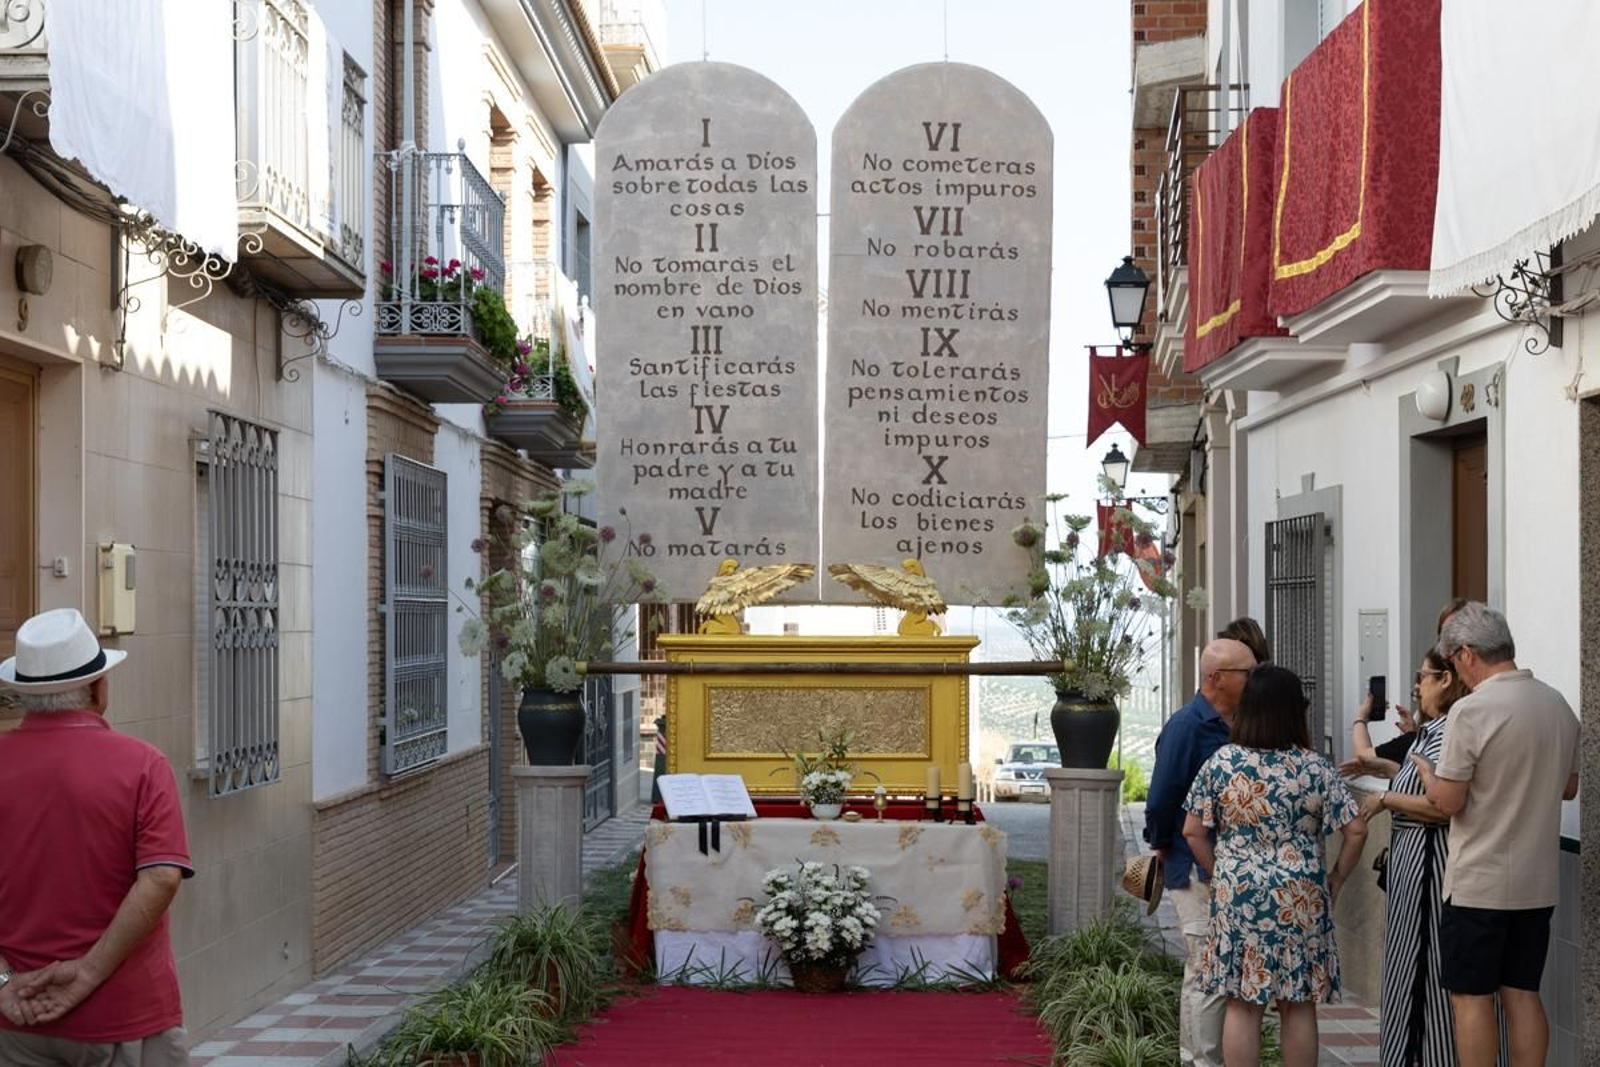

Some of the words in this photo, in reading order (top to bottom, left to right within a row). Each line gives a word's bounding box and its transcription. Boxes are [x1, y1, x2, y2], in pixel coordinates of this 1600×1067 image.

[701, 118, 710, 147] I
[922, 122, 961, 152] VI
[612, 152, 714, 171] Amarás
[721, 157, 736, 170] a
[747, 152, 796, 170] Dios
[863, 153, 892, 171] No
[612, 176, 680, 194] sobre
[686, 175, 757, 193] todas
[770, 175, 808, 193] las
[851, 178, 922, 195] actos
[936, 179, 1036, 204] impuros
[670, 202, 744, 216] cosas
[914, 206, 964, 236] VII
[695, 224, 718, 252] II
[868, 238, 896, 256] No
[914, 240, 1018, 260] robarás
[616, 256, 642, 274] No
[772, 254, 795, 272] el
[615, 277, 701, 296] nombre
[716, 276, 743, 295] de
[753, 278, 802, 295] Dios
[906, 269, 971, 299] VIII
[657, 305, 684, 319] en
[696, 305, 754, 318] vano
[862, 299, 890, 317] No
[901, 302, 1018, 320] mentirás
[691, 325, 723, 355] III
[920, 327, 960, 358] IX
[630, 356, 795, 381] Santificarás
[851, 360, 880, 377] No
[892, 361, 1021, 381] tolerarás
[641, 381, 677, 398] las
[690, 380, 781, 408] fiestas
[848, 384, 1029, 407] pensamientos
[694, 405, 729, 434] IV
[878, 405, 899, 423] ni
[912, 405, 997, 425] deseos
[621, 437, 738, 456] Honrarás
[747, 440, 762, 453] a
[768, 437, 797, 453] tu
[884, 429, 990, 455] impuros
[633, 458, 709, 485] padre
[742, 463, 757, 477] a
[765, 461, 794, 477] tu
[922, 455, 948, 485] X
[669, 480, 747, 500] madre
[852, 488, 880, 506] No
[892, 488, 1025, 509] codiciarás
[695, 507, 721, 536] V
[861, 511, 897, 529] los
[917, 513, 994, 532] bienes
[628, 540, 655, 557] No
[668, 537, 786, 556] matarás
[897, 536, 983, 559] ajenos
